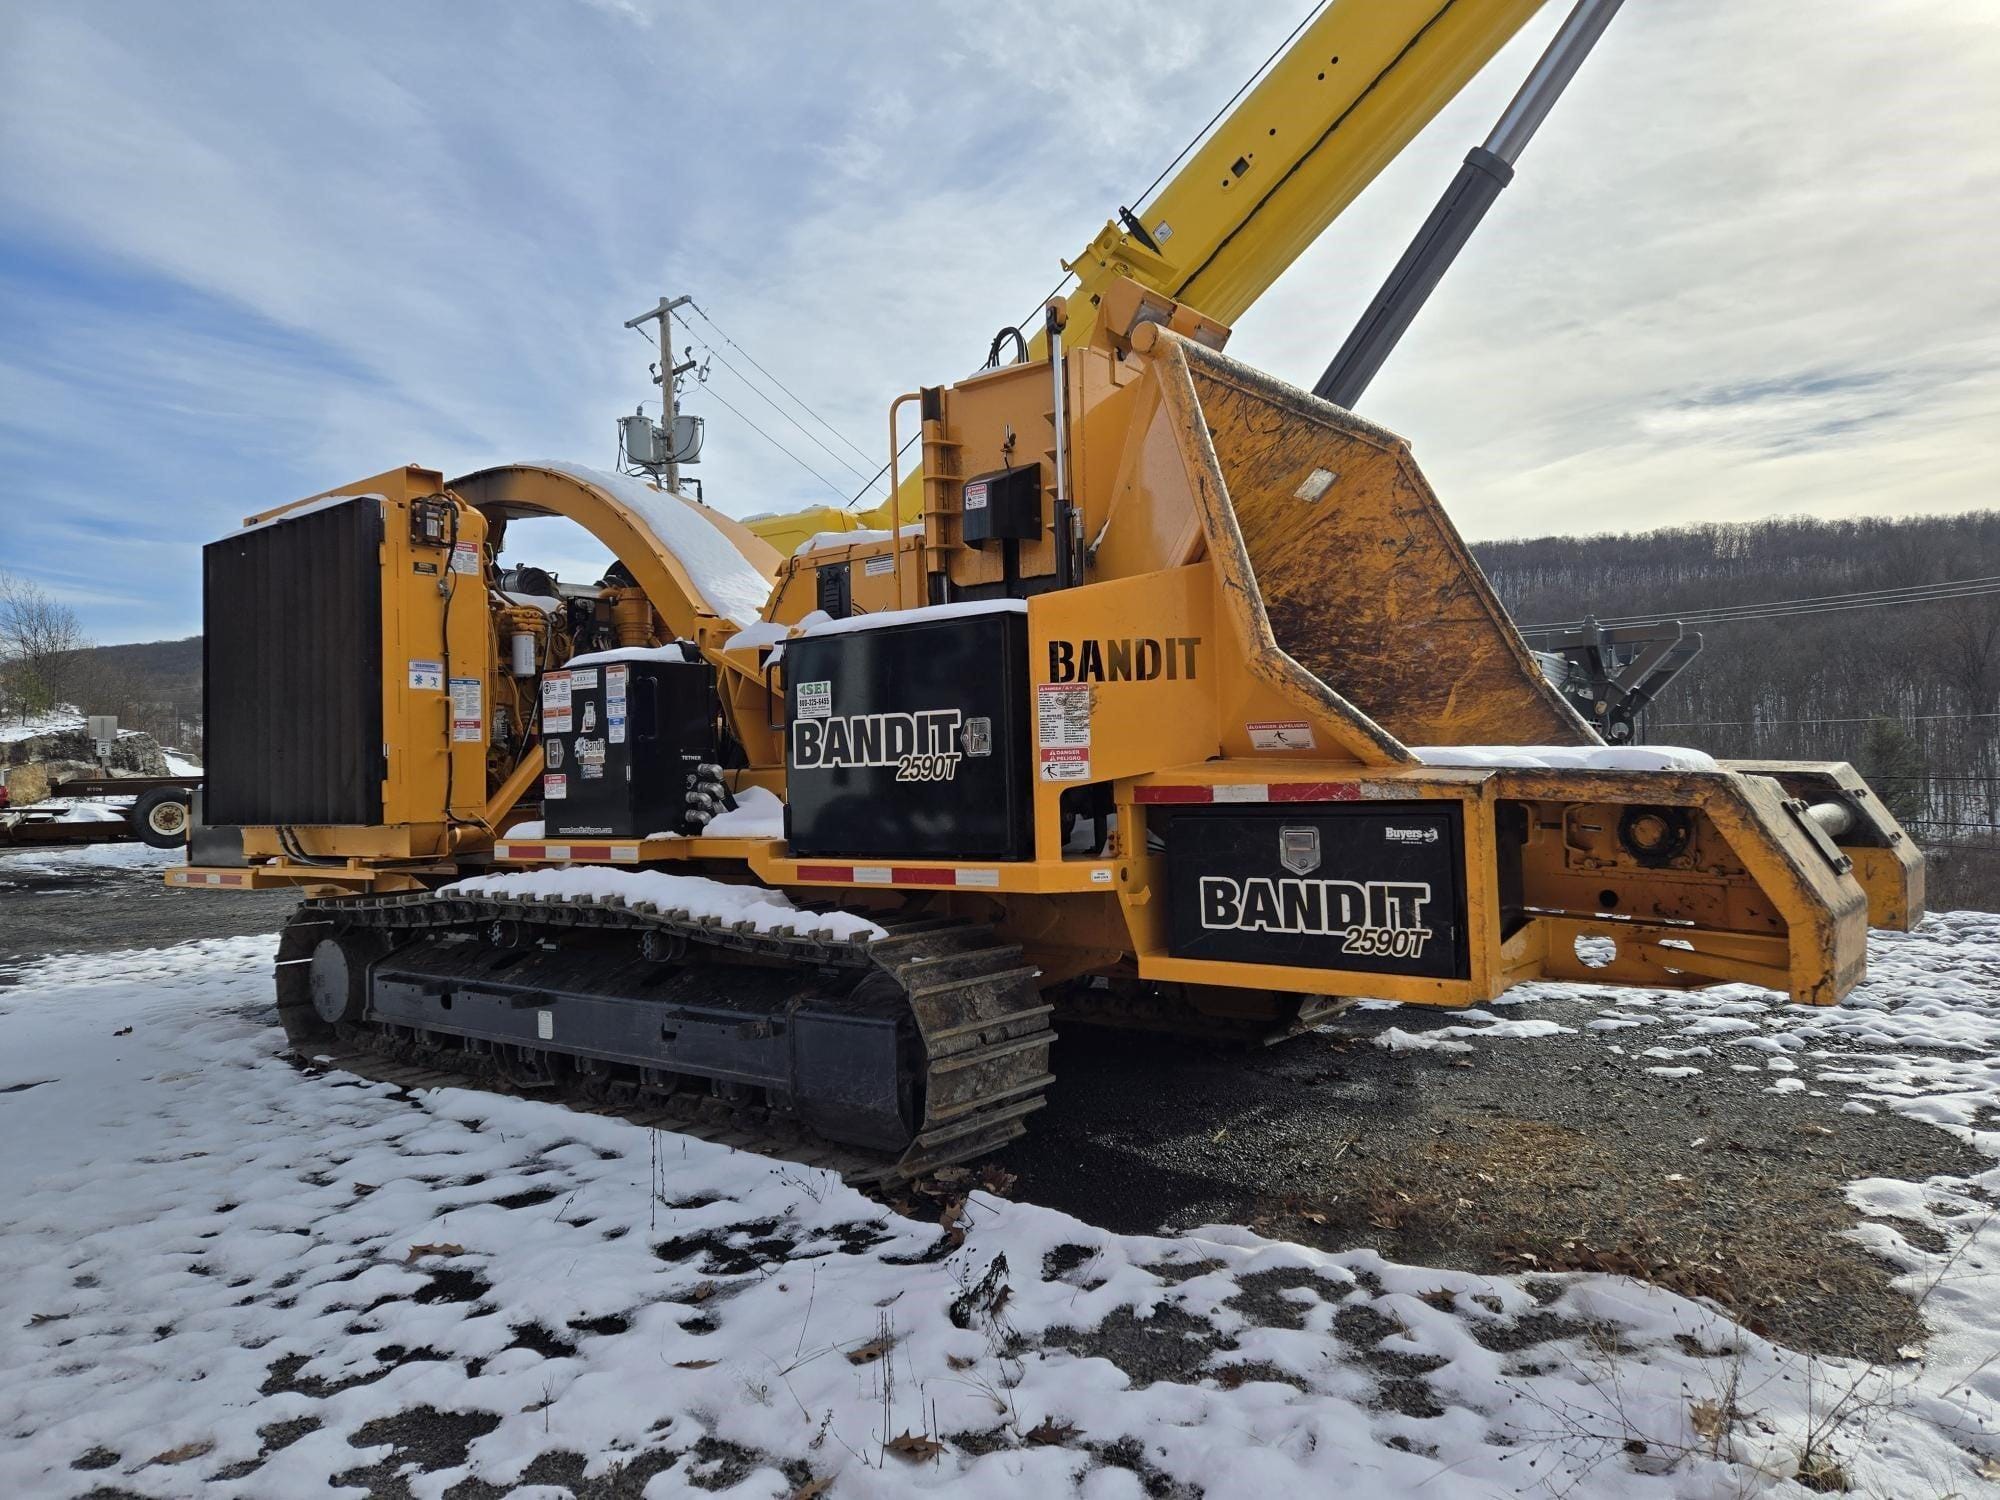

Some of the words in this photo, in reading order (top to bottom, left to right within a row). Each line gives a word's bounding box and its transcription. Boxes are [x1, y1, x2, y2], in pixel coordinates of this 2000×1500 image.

[1048, 637, 1202, 683] BANDIT
[806, 683, 828, 694] SEI
[101, 747, 107, 755] 5
[585, 738, 606, 752] Bandit
[793, 709, 961, 769] BANDIT
[896, 752, 962, 781] 2590T
[1385, 827, 1423, 840] Buyers
[1200, 876, 1430, 936] BANDIT
[1342, 926, 1432, 958] 2590T
